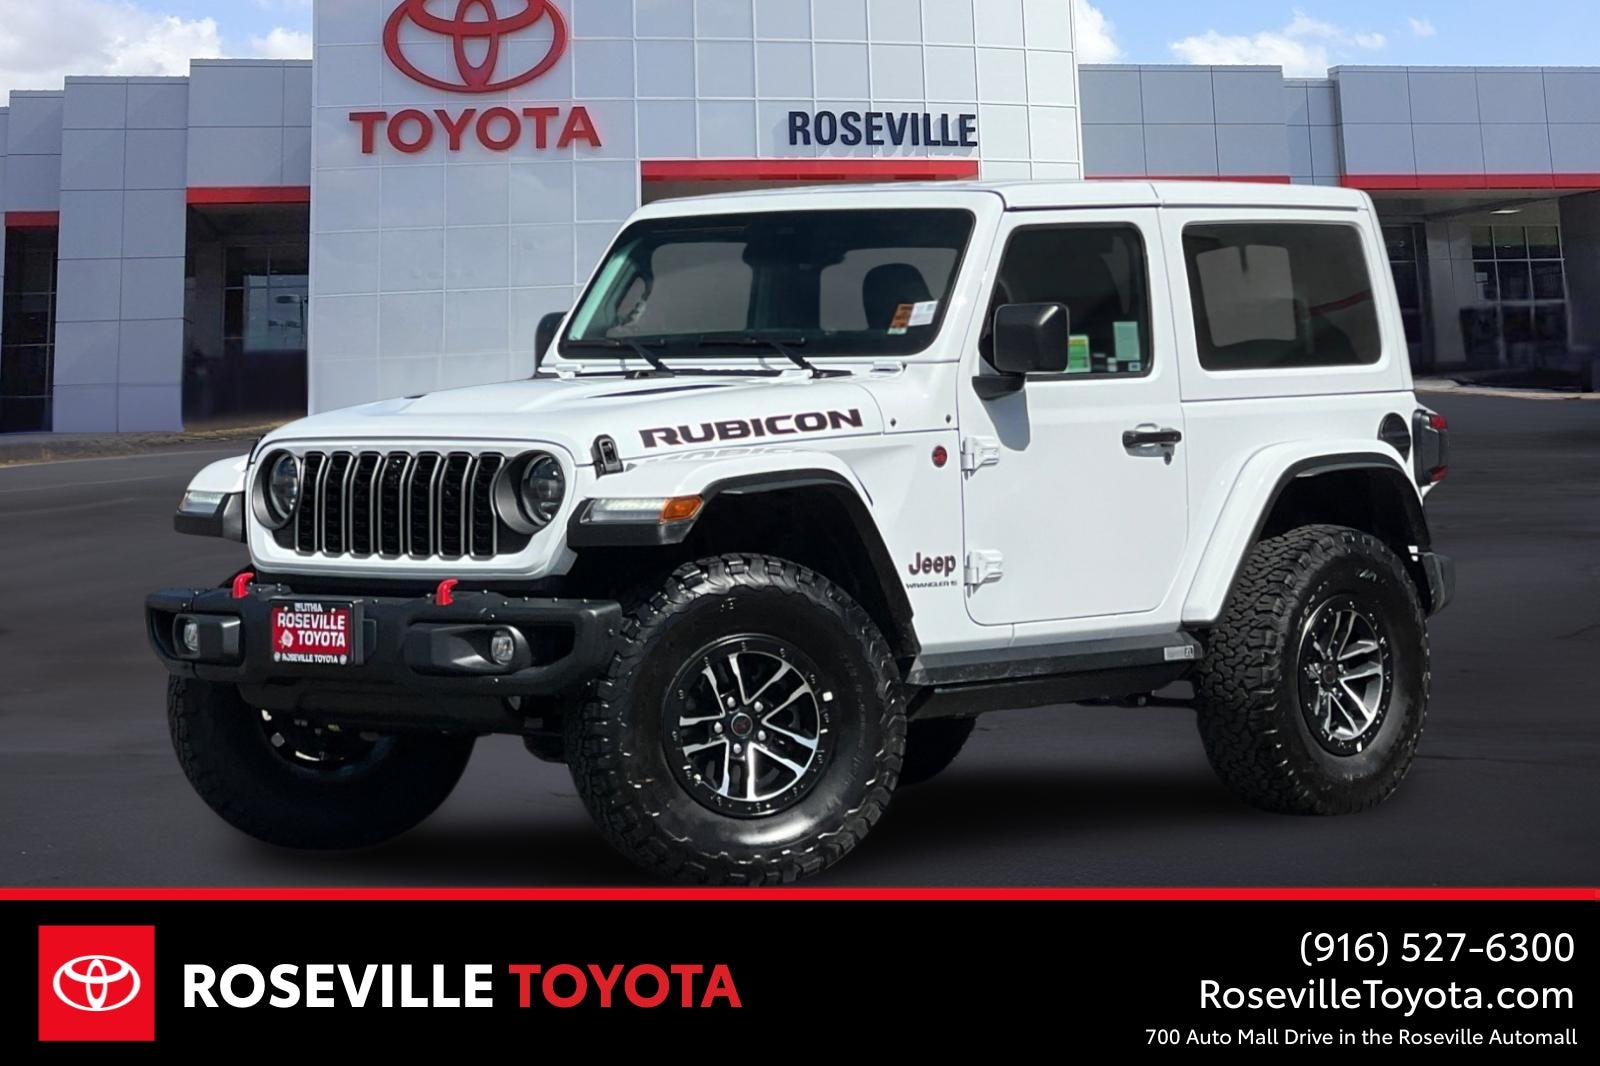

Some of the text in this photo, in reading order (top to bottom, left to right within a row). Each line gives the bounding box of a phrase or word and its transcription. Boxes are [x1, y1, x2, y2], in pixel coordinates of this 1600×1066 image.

[349, 106, 602, 154] TOYOTA
[788, 110, 978, 147] ROSEVILLE
[638, 408, 863, 448] RUBICON
[908, 552, 956, 577] Jeep
[905, 581, 950, 589] WRANGLER
[277, 612, 346, 630] ROSEVILLE
[297, 629, 346, 647] TOYOTA
[314, 654, 338, 664] TOYOTA
